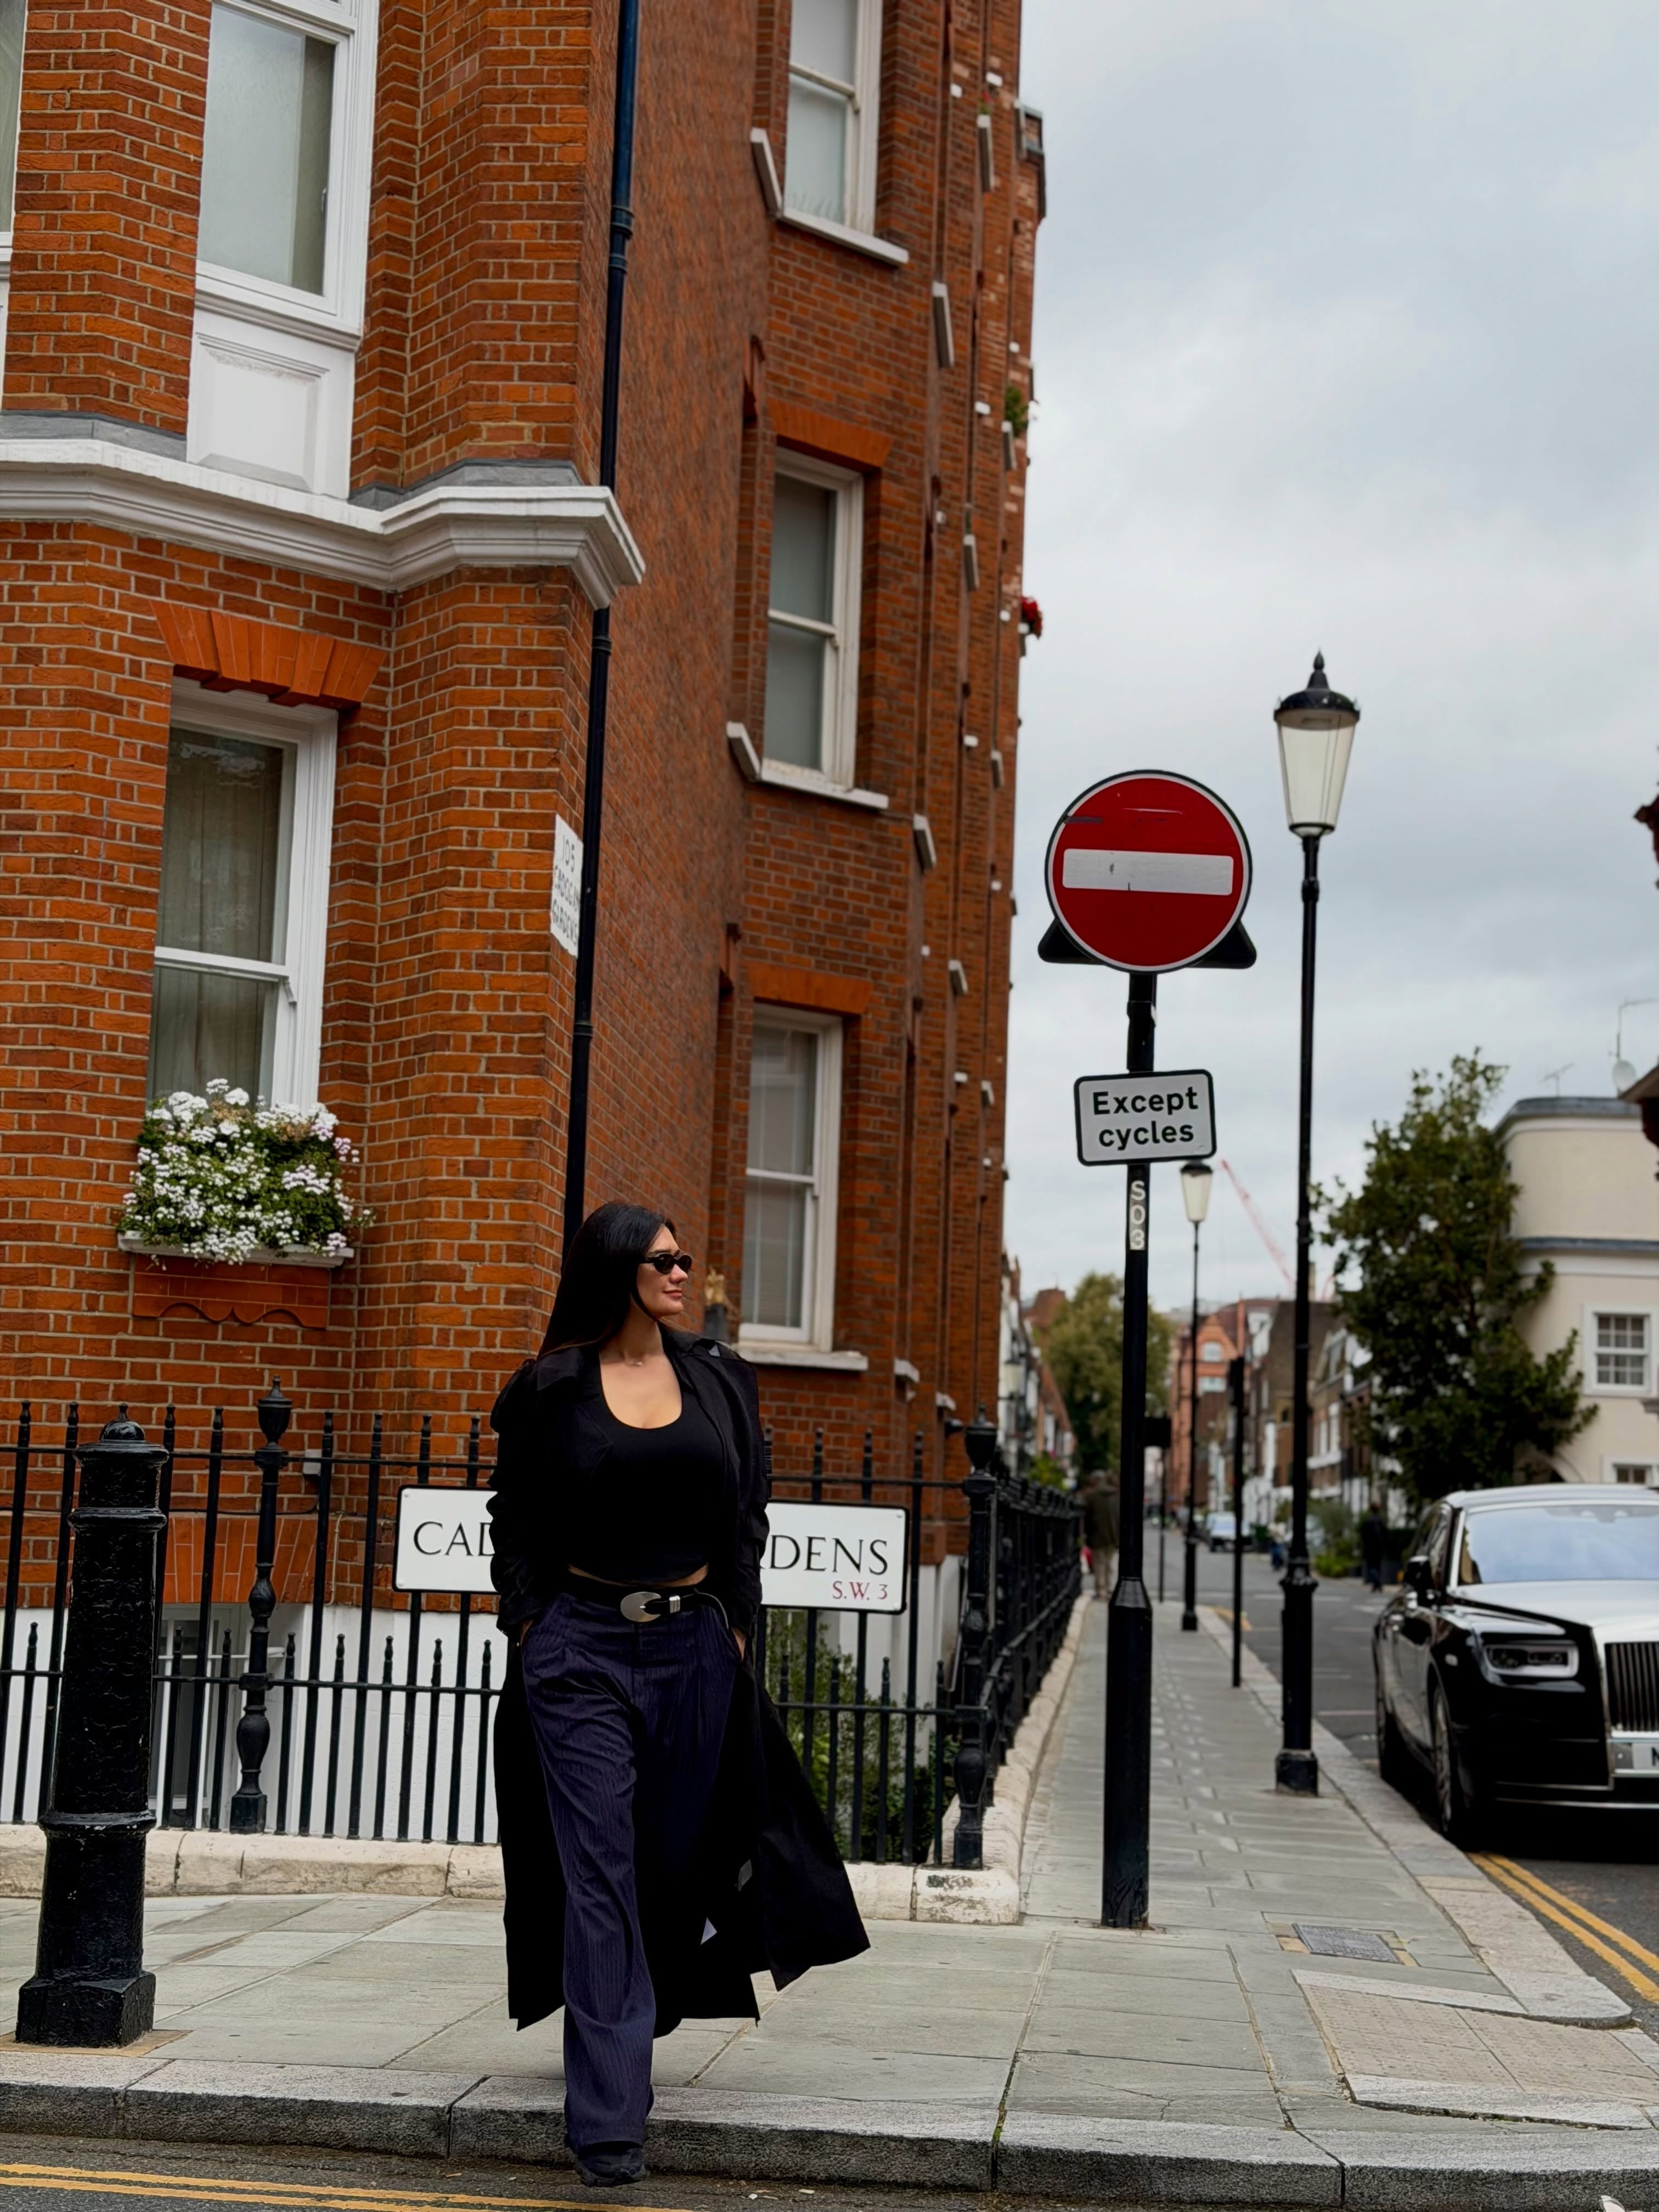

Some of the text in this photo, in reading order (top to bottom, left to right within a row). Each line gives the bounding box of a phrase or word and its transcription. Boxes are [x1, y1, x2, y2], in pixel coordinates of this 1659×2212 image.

[561, 834, 575, 873] 105
[552, 898, 578, 946] GARDENS
[1093, 1086, 1199, 1115] Except
[1098, 1120, 1194, 1151] cycles
[760, 1534, 888, 1576] DENS
[832, 1580, 888, 1601] S.W. 3
